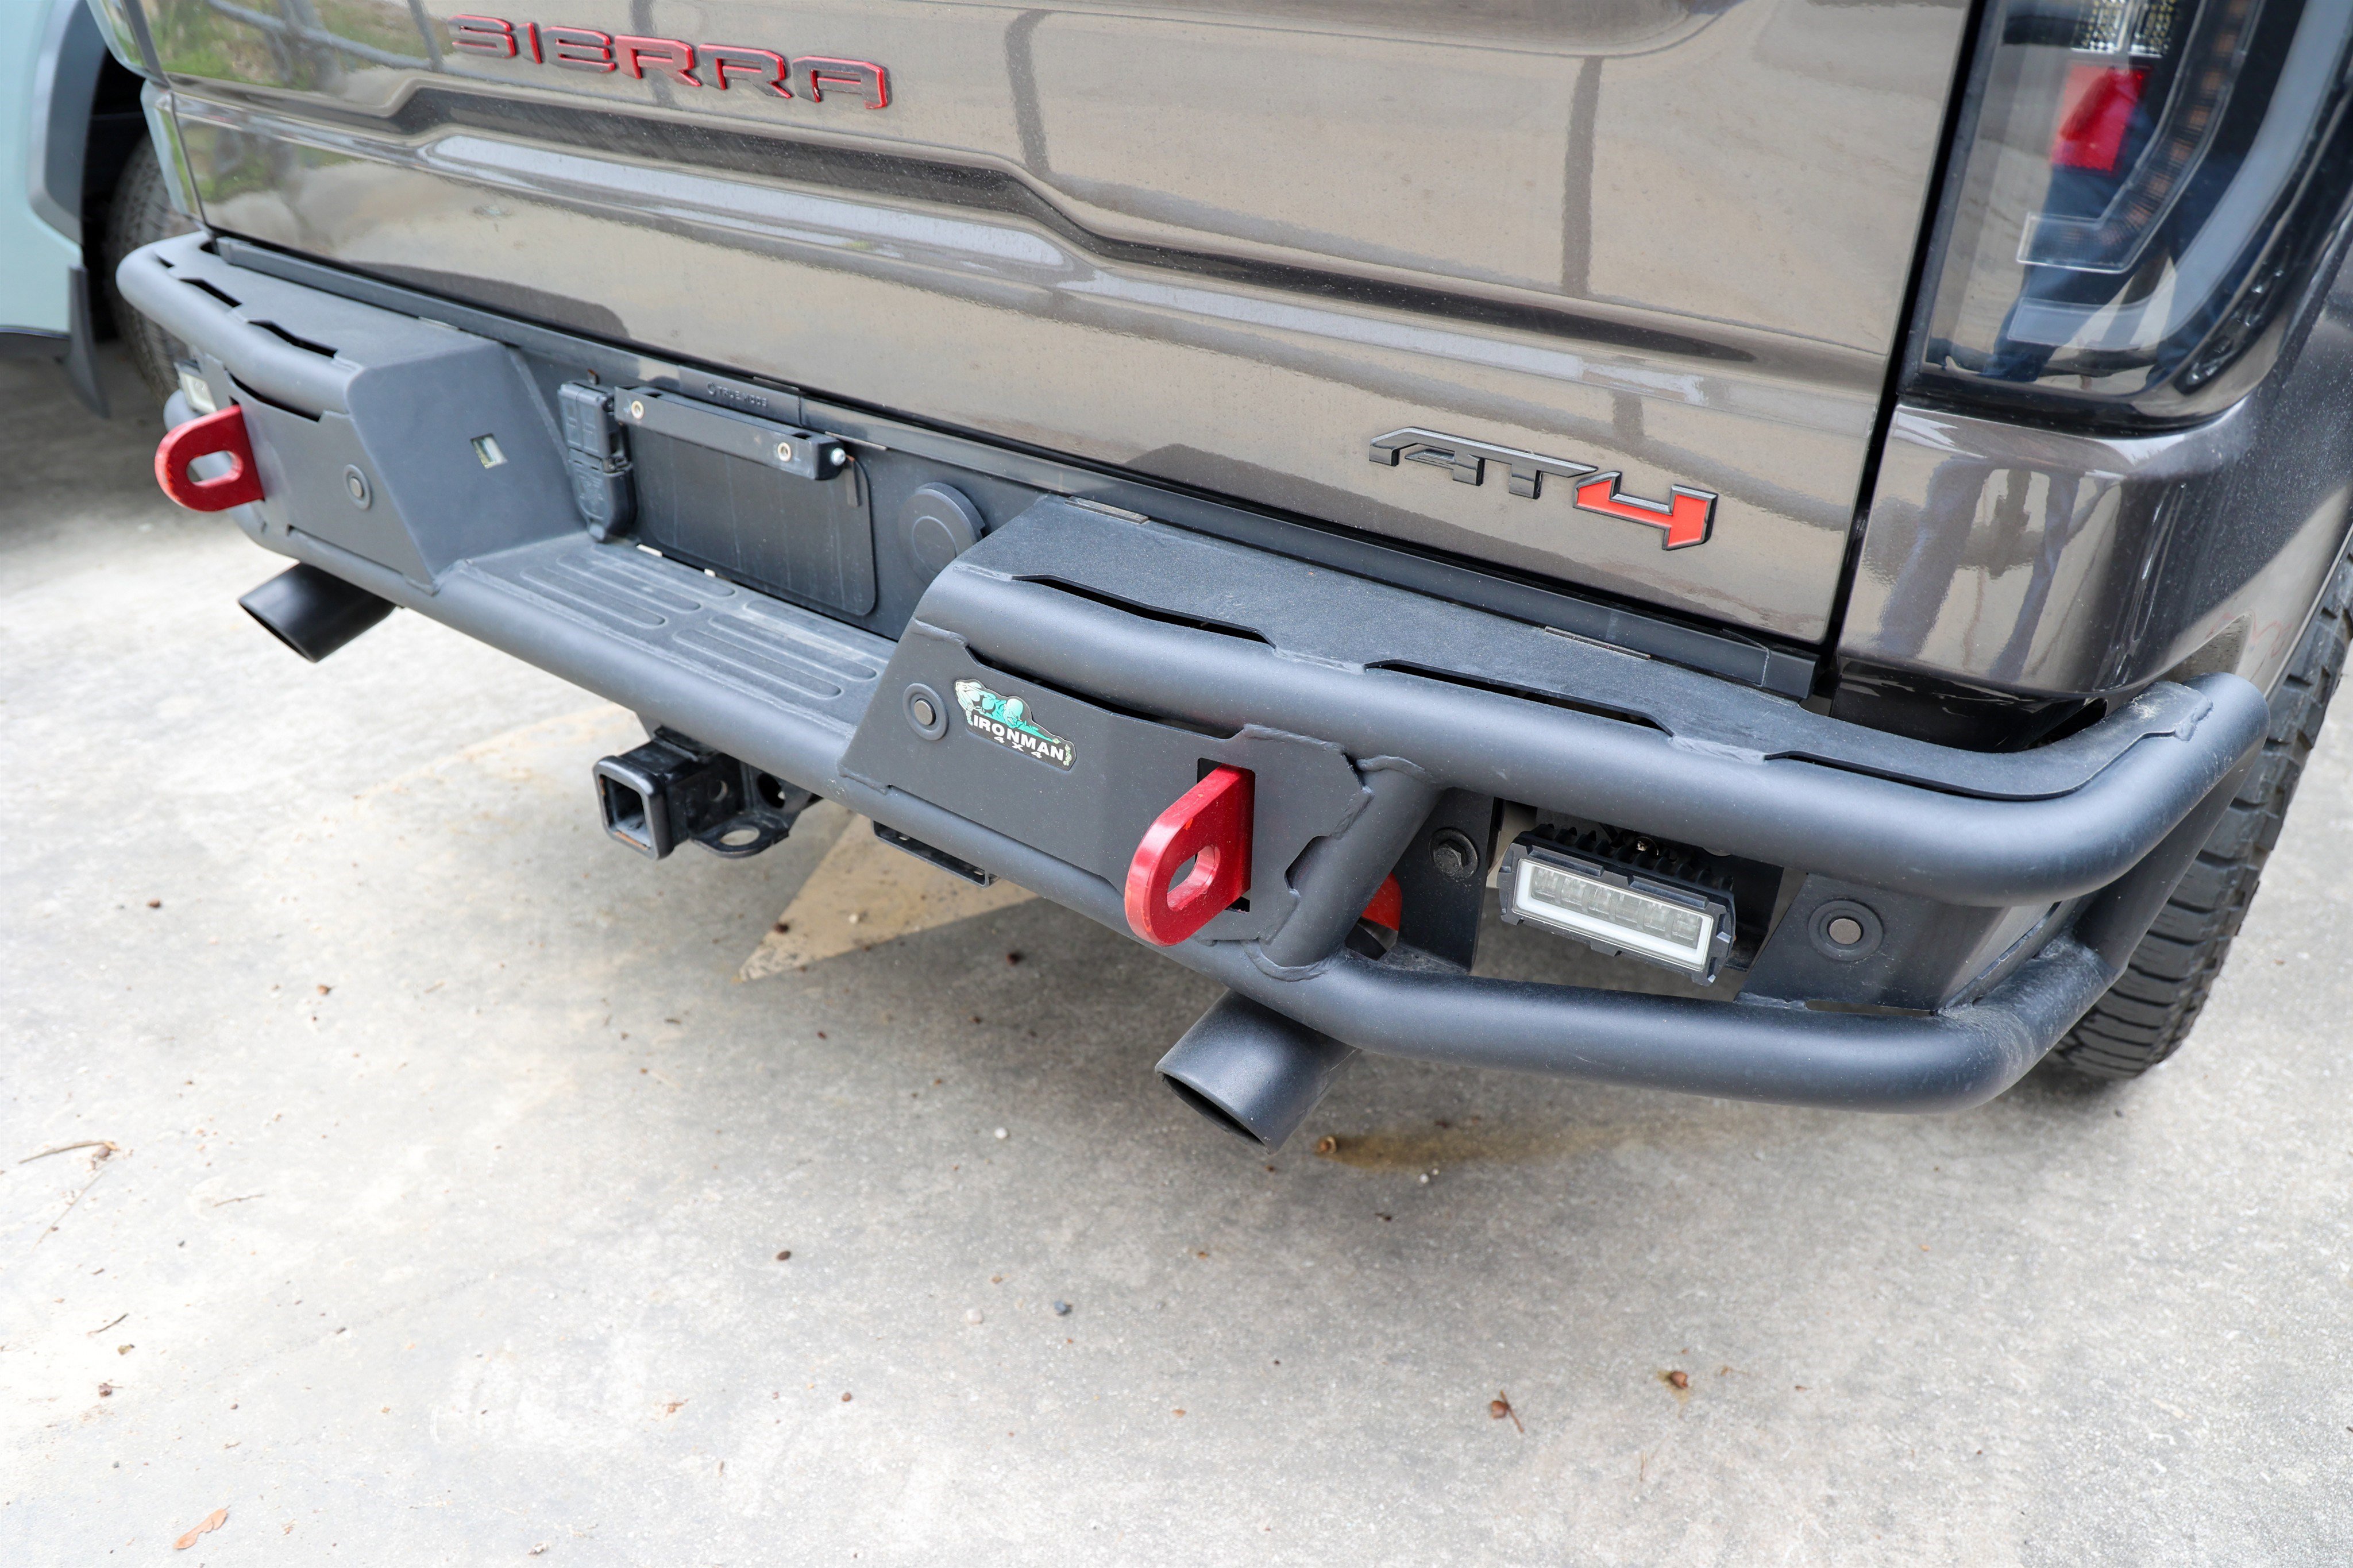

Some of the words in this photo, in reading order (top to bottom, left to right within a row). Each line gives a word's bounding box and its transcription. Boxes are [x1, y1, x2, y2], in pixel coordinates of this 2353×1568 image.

[447, 14, 889, 110] SIERRA
[1369, 426, 1718, 551] AT4
[973, 715, 1064, 761] IRONMAN
